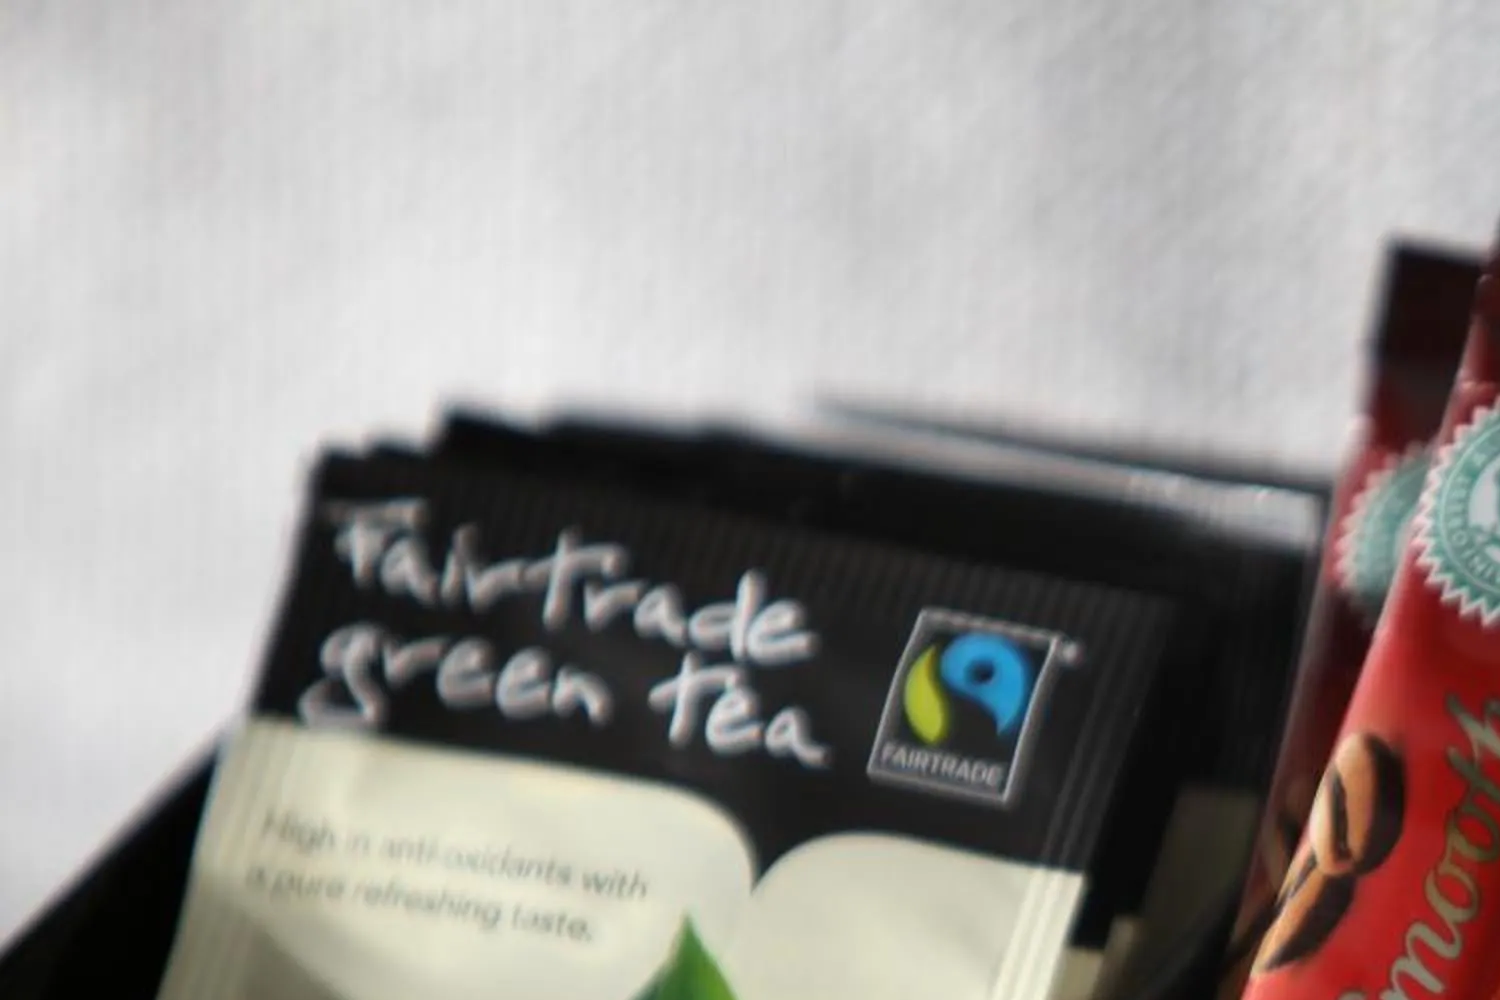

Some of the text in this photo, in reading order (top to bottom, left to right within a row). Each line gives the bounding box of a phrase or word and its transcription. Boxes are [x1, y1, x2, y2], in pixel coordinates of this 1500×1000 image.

[326, 498, 820, 666] Fairtrade
[299, 622, 832, 768] green tea
[880, 742, 1003, 786] FAIRTRADE
[262, 812, 336, 854] High
[579, 868, 650, 899] with
[269, 868, 347, 904] pure
[352, 880, 501, 931] refreshing
